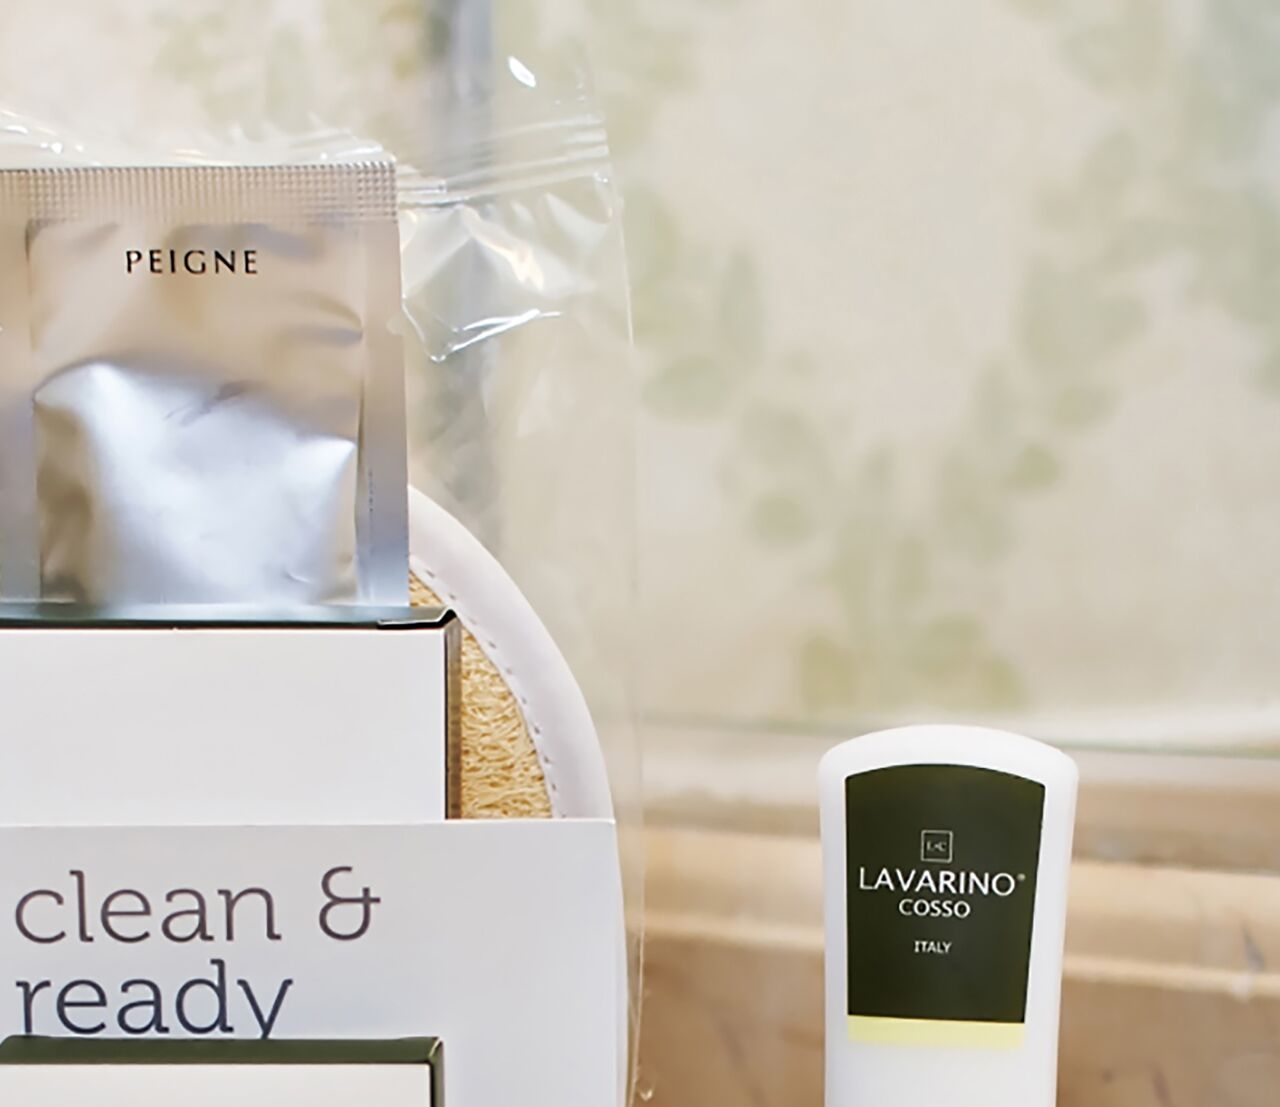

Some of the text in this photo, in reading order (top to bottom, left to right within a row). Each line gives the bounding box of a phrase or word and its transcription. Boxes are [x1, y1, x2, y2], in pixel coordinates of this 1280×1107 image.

[125, 248, 258, 275] PEIGNE
[15, 866, 382, 944] clean &
[898, 898, 971, 918] COSSO
[913, 940, 953, 954] ITALY
[15, 957, 294, 1039] ready
